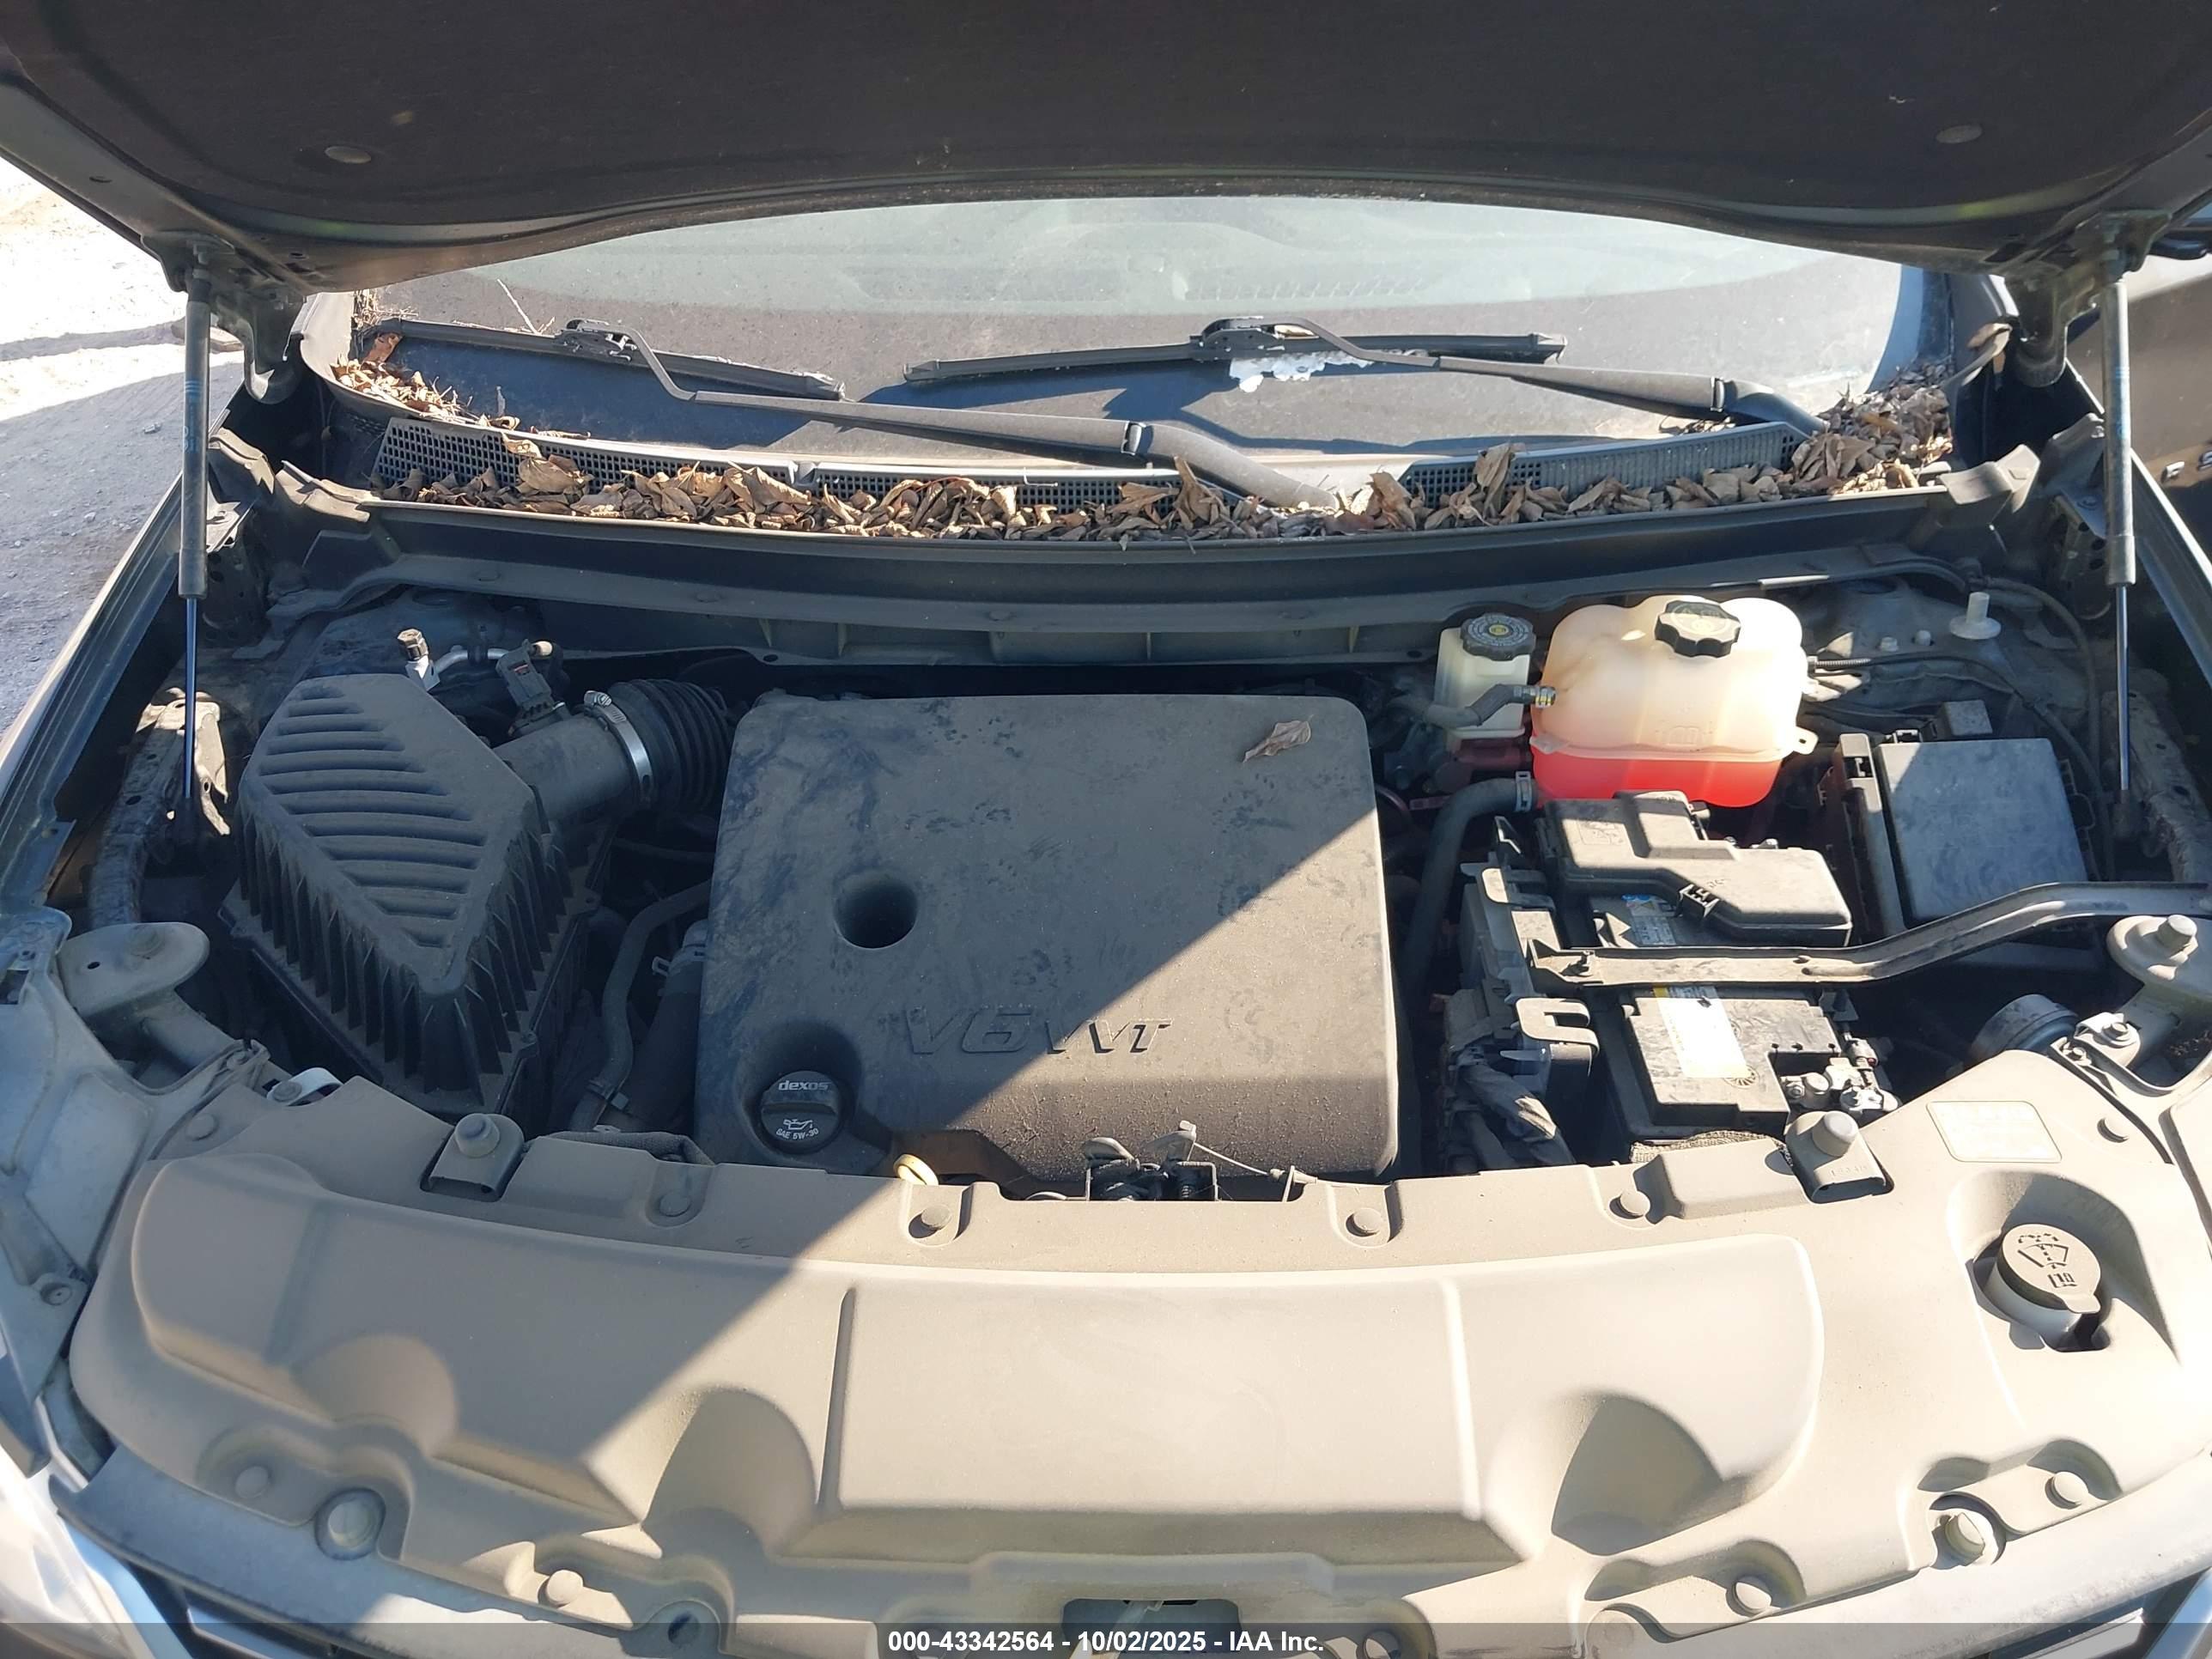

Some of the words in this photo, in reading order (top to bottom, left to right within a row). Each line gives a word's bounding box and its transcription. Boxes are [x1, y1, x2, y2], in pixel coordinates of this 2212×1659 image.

[905, 1006, 1034, 1054] V6
[778, 1079, 831, 1091] dexos
[775, 1127, 791, 1139] SAE
[793, 1127, 819, 1140] 5W-30
